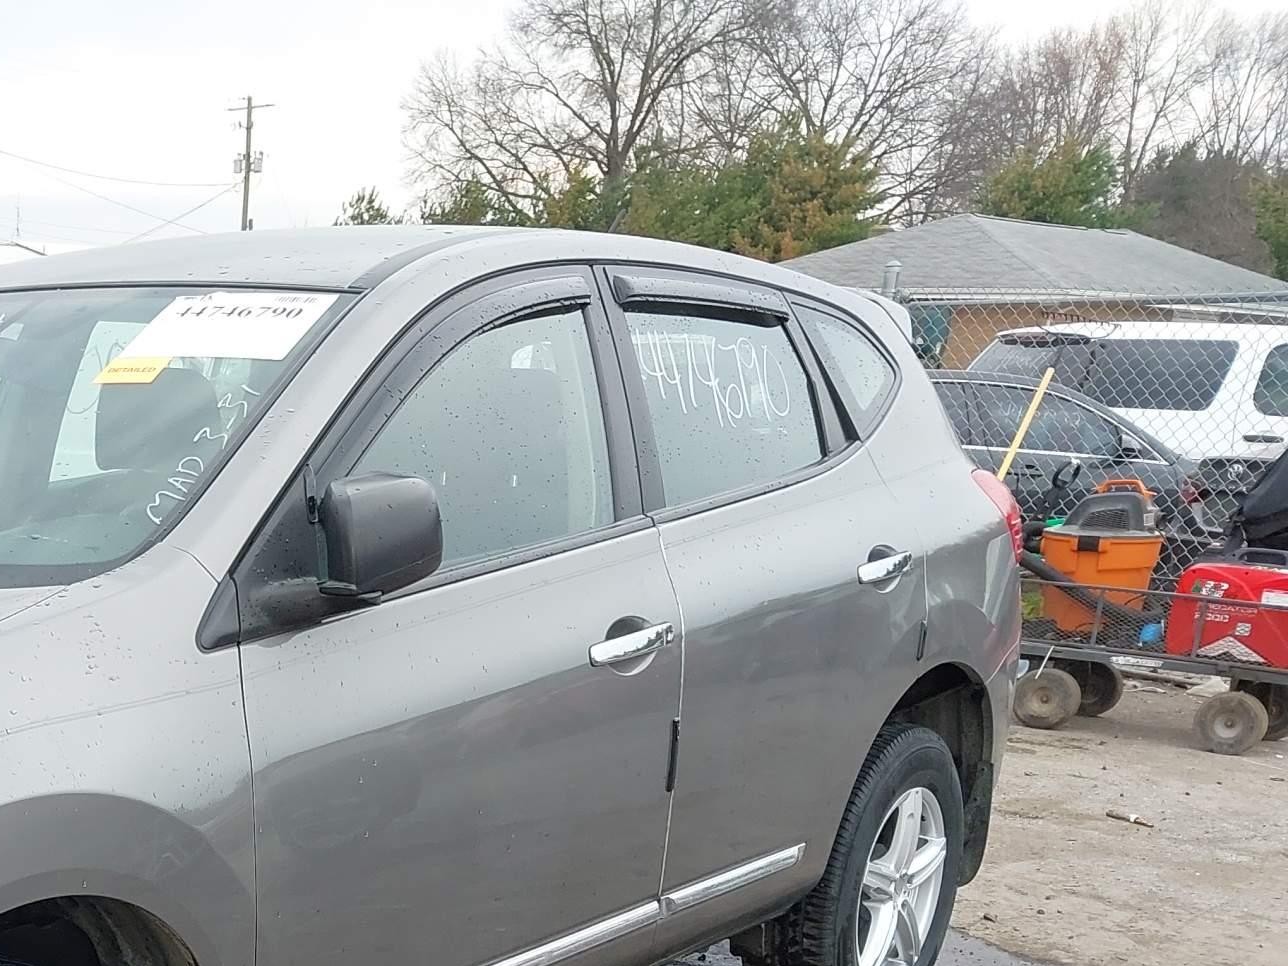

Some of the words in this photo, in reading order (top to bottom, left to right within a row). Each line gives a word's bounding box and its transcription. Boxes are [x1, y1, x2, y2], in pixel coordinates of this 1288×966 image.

[176, 305, 304, 318] 44746790
[636, 328, 790, 428] 44746790
[147, 456, 204, 525] MAD
